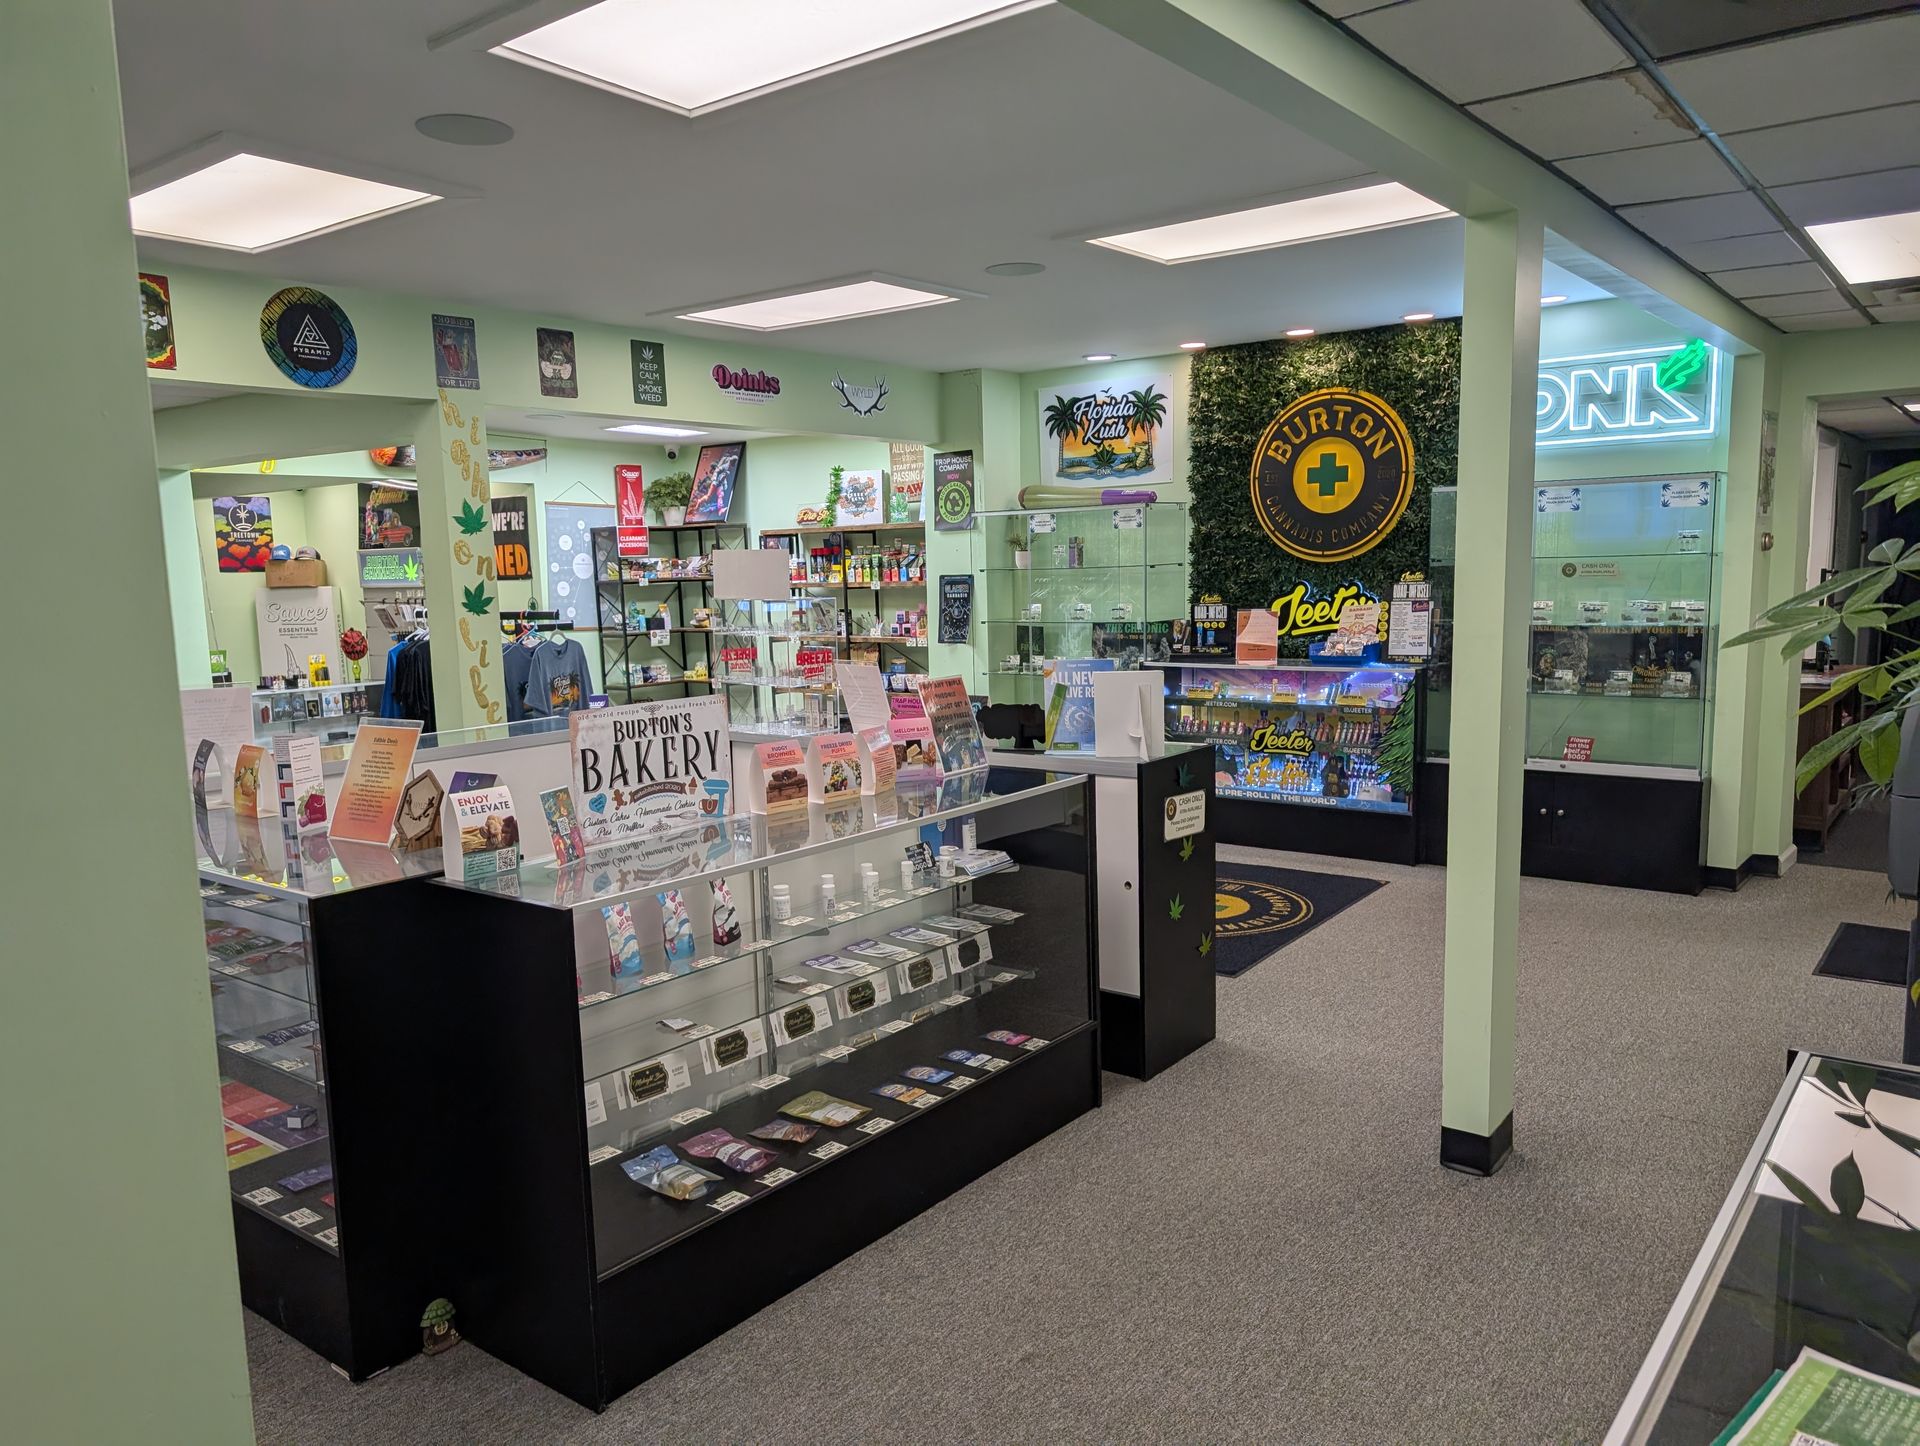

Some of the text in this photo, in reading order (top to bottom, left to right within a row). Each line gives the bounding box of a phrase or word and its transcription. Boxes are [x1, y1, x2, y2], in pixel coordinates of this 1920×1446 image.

[293, 346, 331, 356] PYRAMID
[639, 362, 658, 371] KEEP
[639, 371, 660, 380] CALM
[712, 364, 781, 395] Doinks
[440, 378, 456, 386] FOR
[637, 384, 663, 394] SMOKE
[851, 386, 874, 399] WYLD
[640, 394, 662, 402] WEED
[1073, 395, 1137, 423] Florida
[1084, 419, 1127, 444] Kush
[1267, 405, 1395, 465] BURTON
[892, 443, 905, 454] ALL
[951, 456, 972, 464] HOUSE
[893, 463, 911, 471] START
[939, 463, 968, 472] COMPANY
[893, 471, 920, 482] PASSING
[492, 511, 524, 532] WE'RE
[1266, 493, 1391, 543] CANNABIS COMPANY
[230, 531, 259, 539] TREETOWN
[619, 541, 648, 549] ACCESSORIES
[366, 555, 399, 567] BURTON
[494, 543, 531, 576] NED.
[363, 567, 405, 580] CANNABIS
[266, 602, 329, 623] Sauce
[278, 626, 318, 634] ESSENTIALS
[1105, 623, 1169, 634] THE CHNIC
[1533, 624, 1568, 632] ANNABIS
[1646, 626, 1673, 634] YOUR
[796, 650, 834, 666] BREEZE
[1050, 671, 1071, 685] ALL
[1066, 686, 1084, 698] LIVE
[666, 703, 687, 711] baked
[708, 698, 726, 706] daily
[907, 697, 922, 705] HOU
[592, 711, 614, 719] world
[616, 708, 641, 717] recipe
[613, 712, 693, 743] BURTON'S
[1204, 737, 1238, 745] JEETER.COM
[1250, 723, 1314, 753] Jeeter
[820, 740, 853, 750] FREEZE DRIED
[767, 751, 796, 759] BROWNIES
[580, 729, 721, 794] BAKERY
[457, 794, 489, 807] ENJOY
[1179, 794, 1203, 805] CASH ONLY
[1225, 789, 1270, 799] PRE-ROLL
[1271, 792, 1281, 800] IN
[1281, 793, 1302, 802] THE
[1302, 795, 1337, 806] WORLD
[460, 800, 511, 817] & ELEVATE
[582, 799, 697, 829] Custom Cakes Homemade Cookies
[618, 822, 645, 834] Muffins
